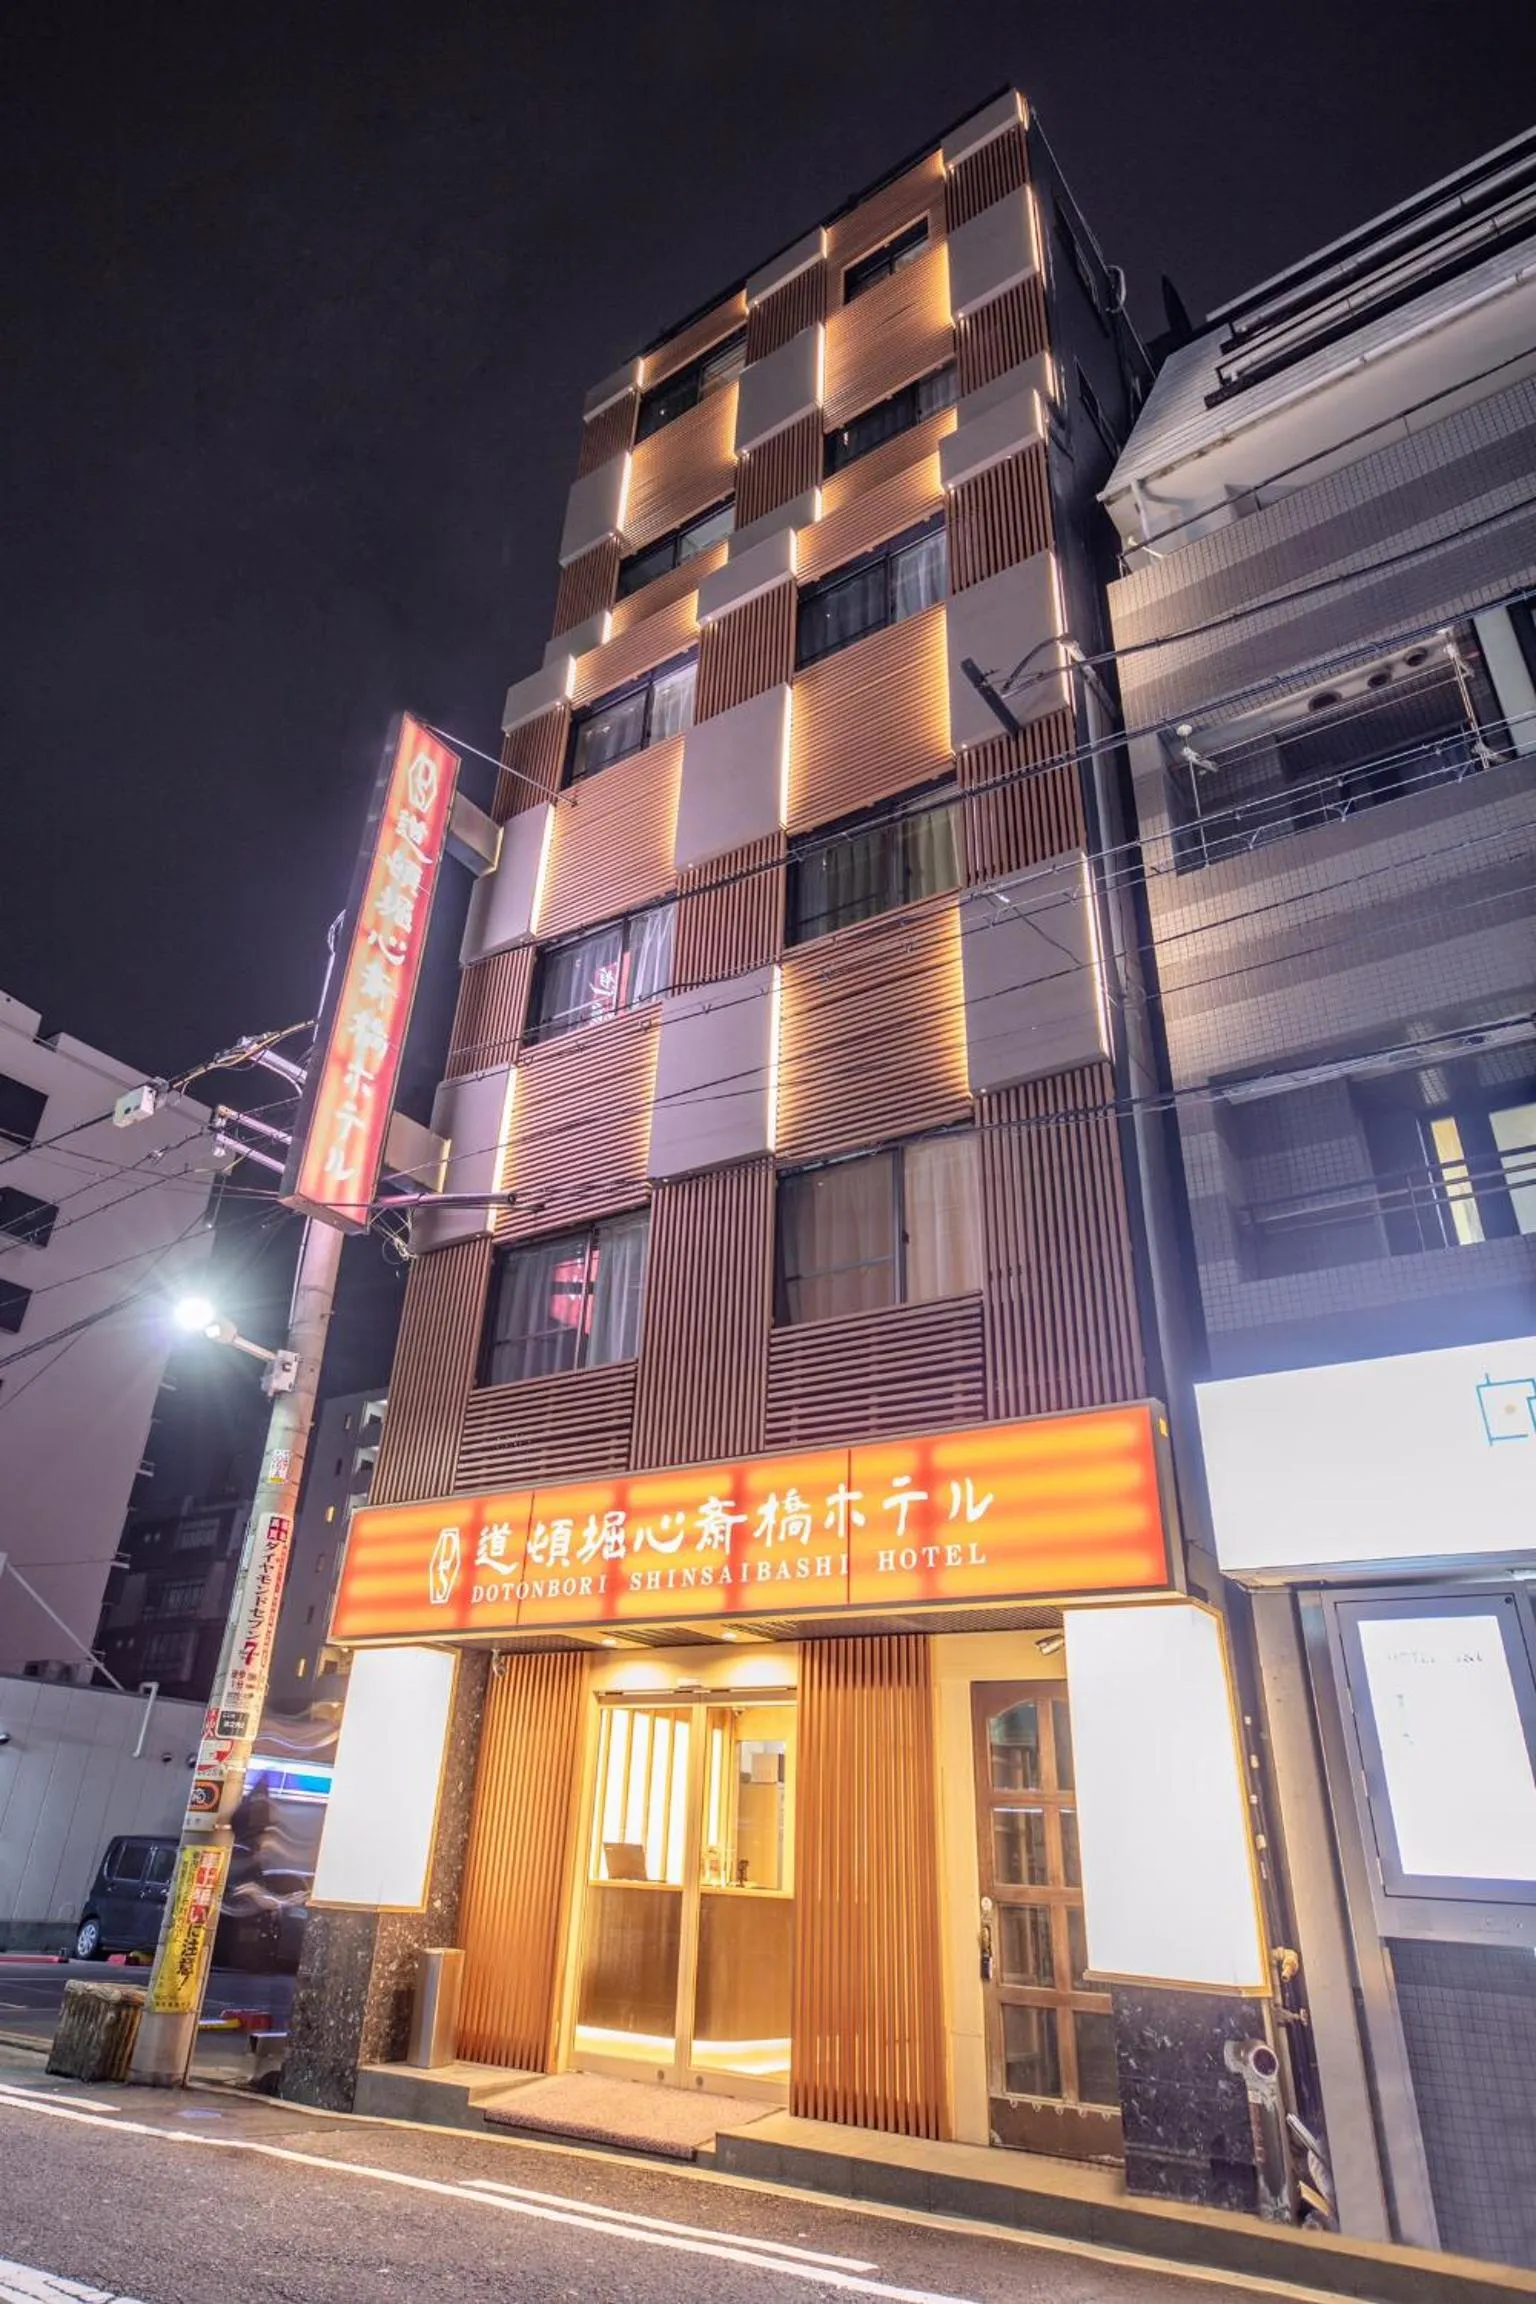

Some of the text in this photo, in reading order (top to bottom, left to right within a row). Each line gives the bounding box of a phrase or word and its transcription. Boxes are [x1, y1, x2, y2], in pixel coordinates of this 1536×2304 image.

[324, 809, 433, 1181] 道頓堀心斎橋ホテル
[471, 1542, 987, 1604] DOTONBORI SHINSAIBASHI HOTEL
[475, 1476, 994, 1576] 道頓堀心斎橋ホテル
